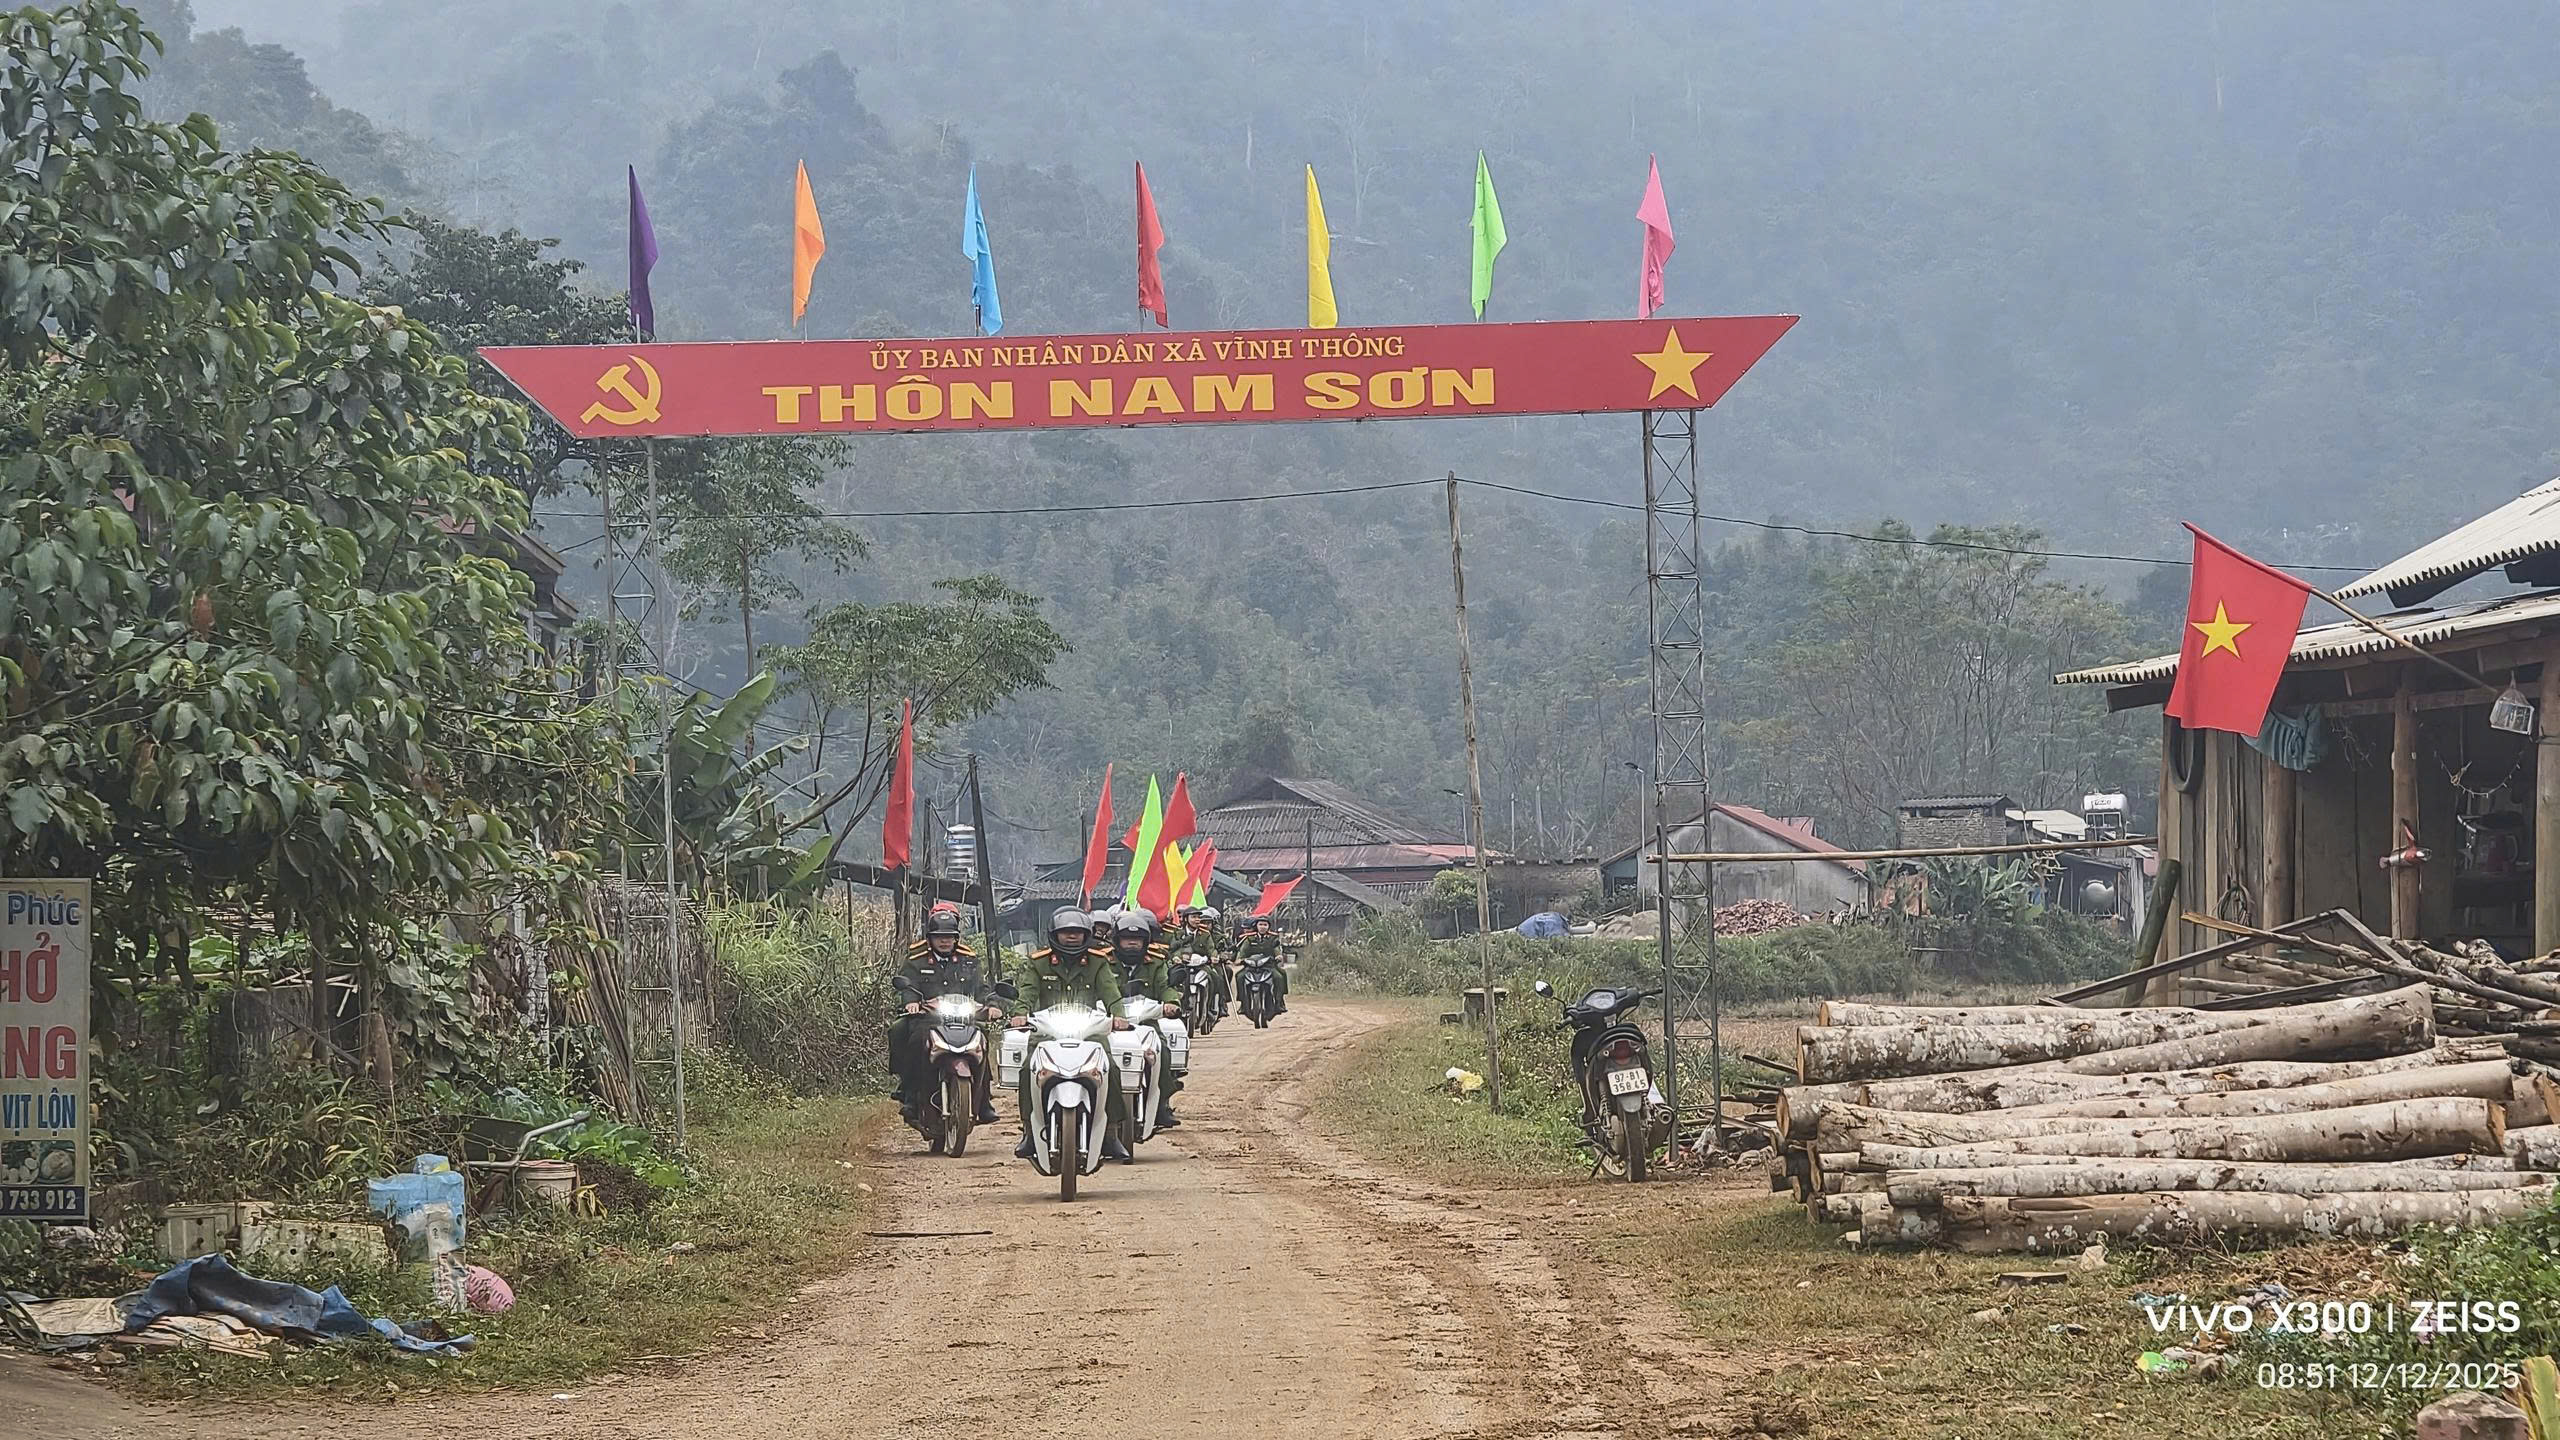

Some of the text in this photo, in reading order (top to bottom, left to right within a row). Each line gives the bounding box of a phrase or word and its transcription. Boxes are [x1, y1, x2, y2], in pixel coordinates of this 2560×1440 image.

[869, 332, 1406, 370] ỦY BAN NHÂN DÂN XÃ VĨNH THÔNG
[762, 366, 1495, 424] THÔN NAM SƠN
[8, 889, 81, 925] Phúc
[0, 1026, 77, 1079] NG
[2, 1087, 76, 1136] VỊT LỘN
[9, 1190, 40, 1210] 733
[45, 1190, 76, 1210] 912
